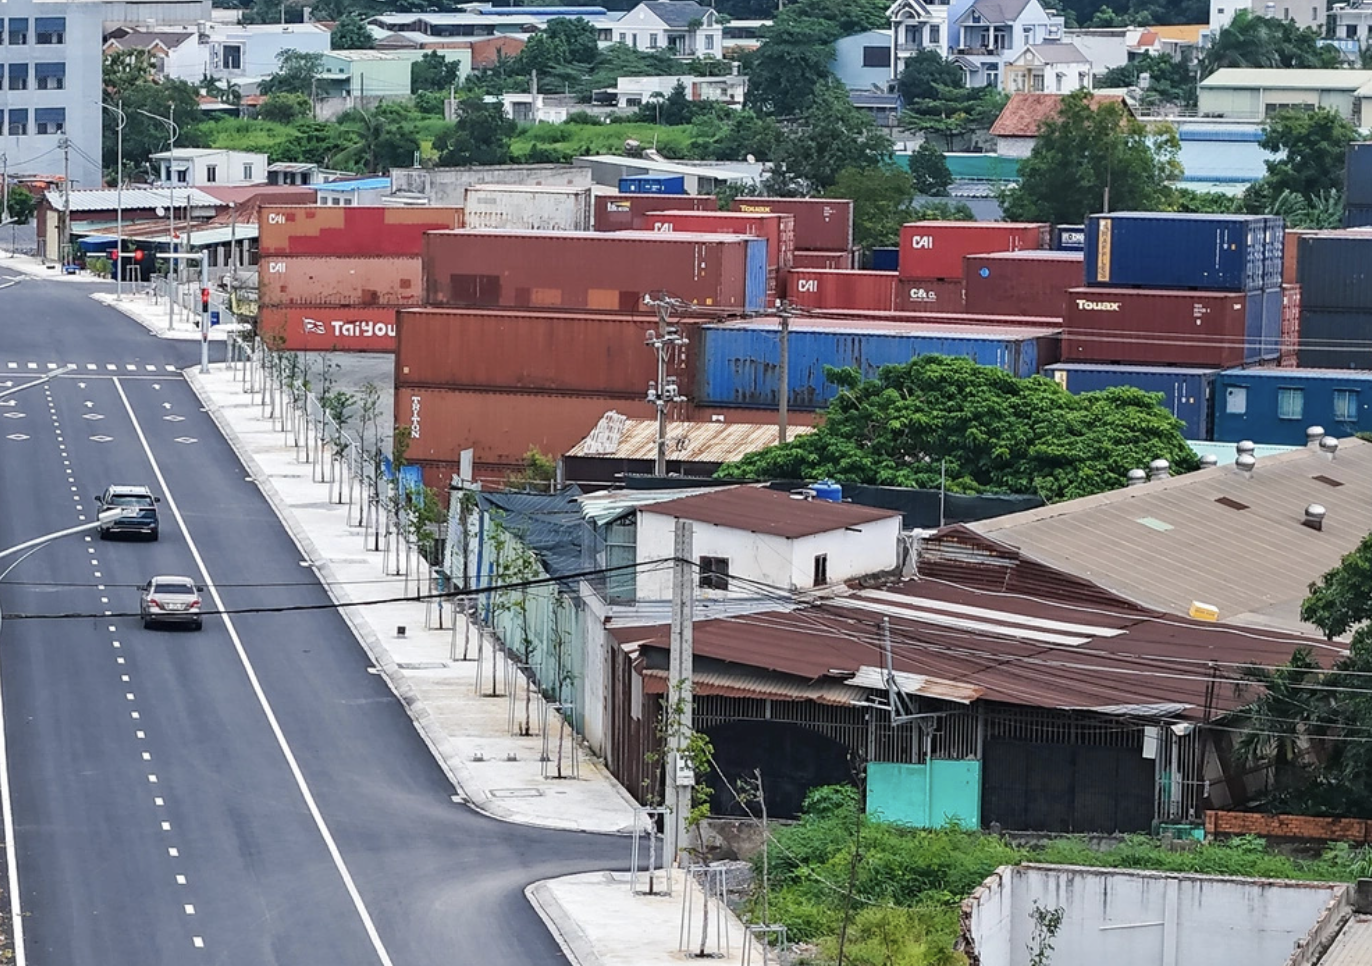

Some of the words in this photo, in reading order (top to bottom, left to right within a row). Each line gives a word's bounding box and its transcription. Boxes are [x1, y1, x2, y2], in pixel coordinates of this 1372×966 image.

[912, 236, 933, 249] CAI
[798, 279, 818, 292] CAI
[411, 396, 421, 438] TRITON
